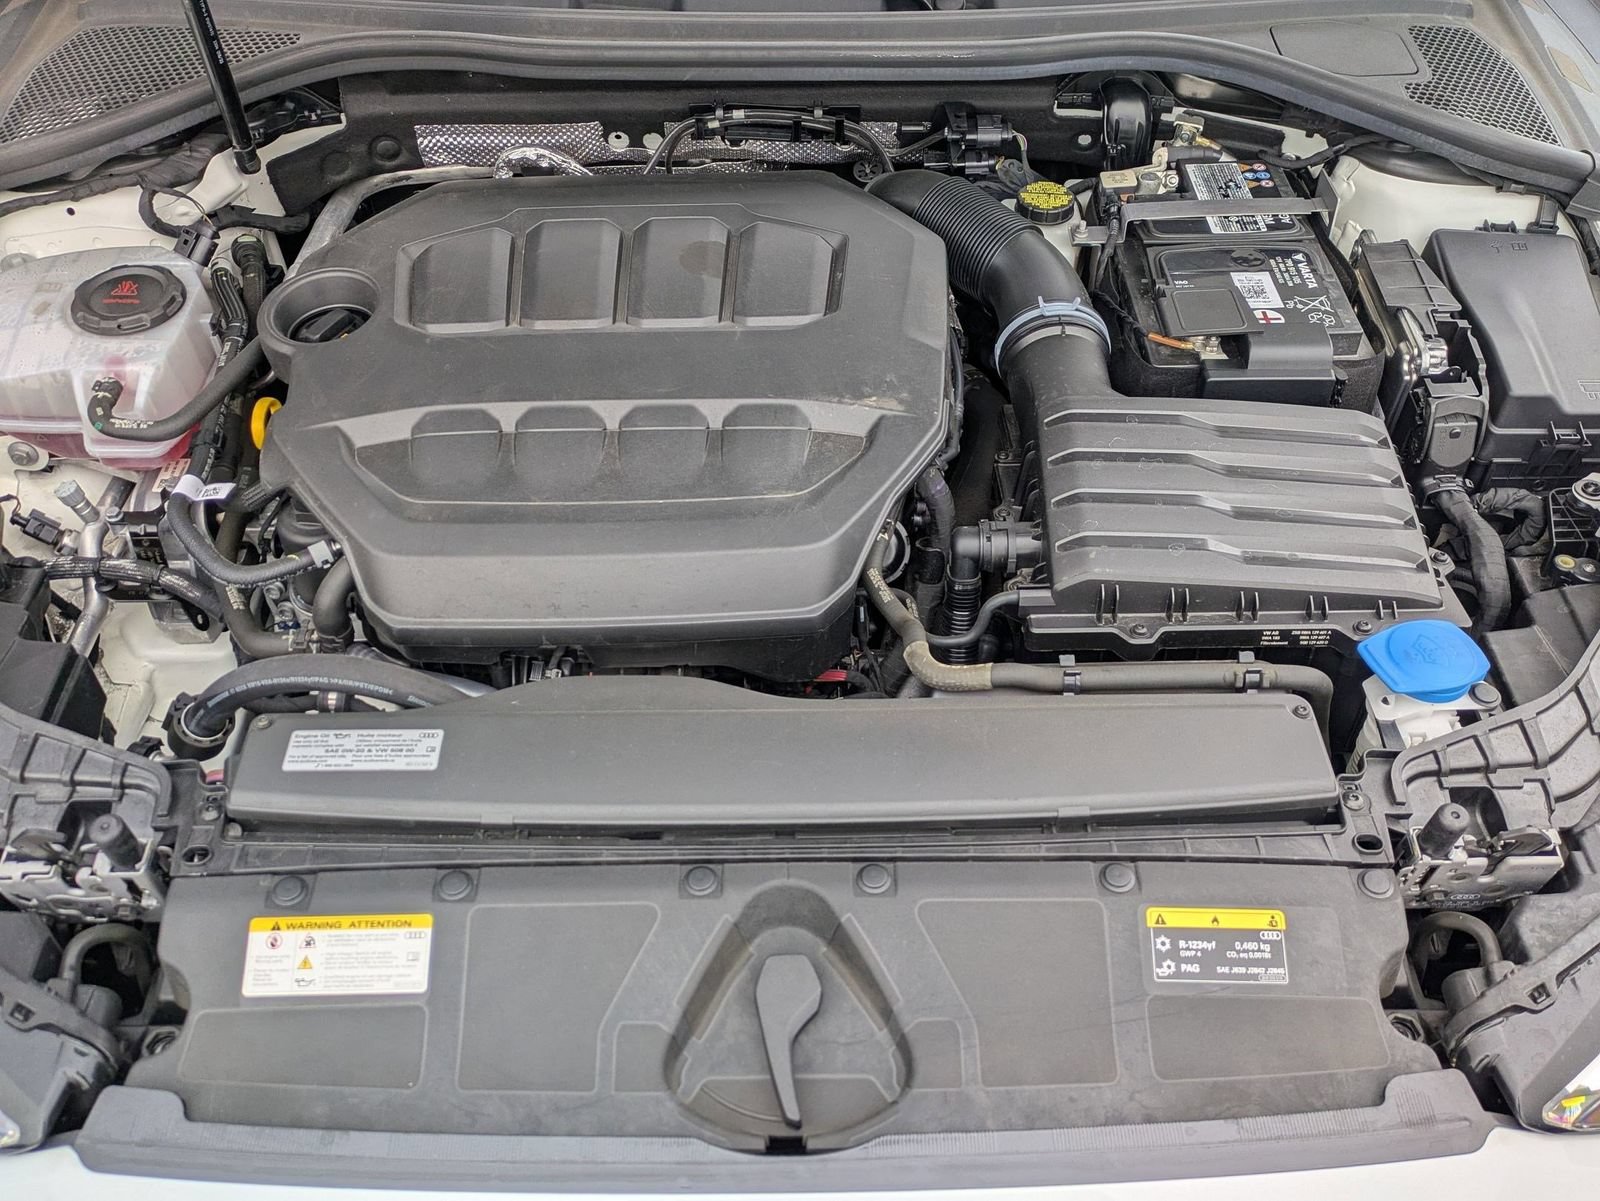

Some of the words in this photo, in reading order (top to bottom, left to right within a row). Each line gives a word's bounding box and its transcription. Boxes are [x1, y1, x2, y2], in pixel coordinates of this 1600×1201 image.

[1297, 262, 1319, 288] VARTA
[1284, 300, 1295, 309] Pb
[286, 920, 342, 930] WARNING
[349, 919, 412, 929] ATTENTION
[1179, 940, 1216, 951] R-1234yf
[1259, 942, 1271, 952] kg
[1180, 963, 1200, 973] PAG
